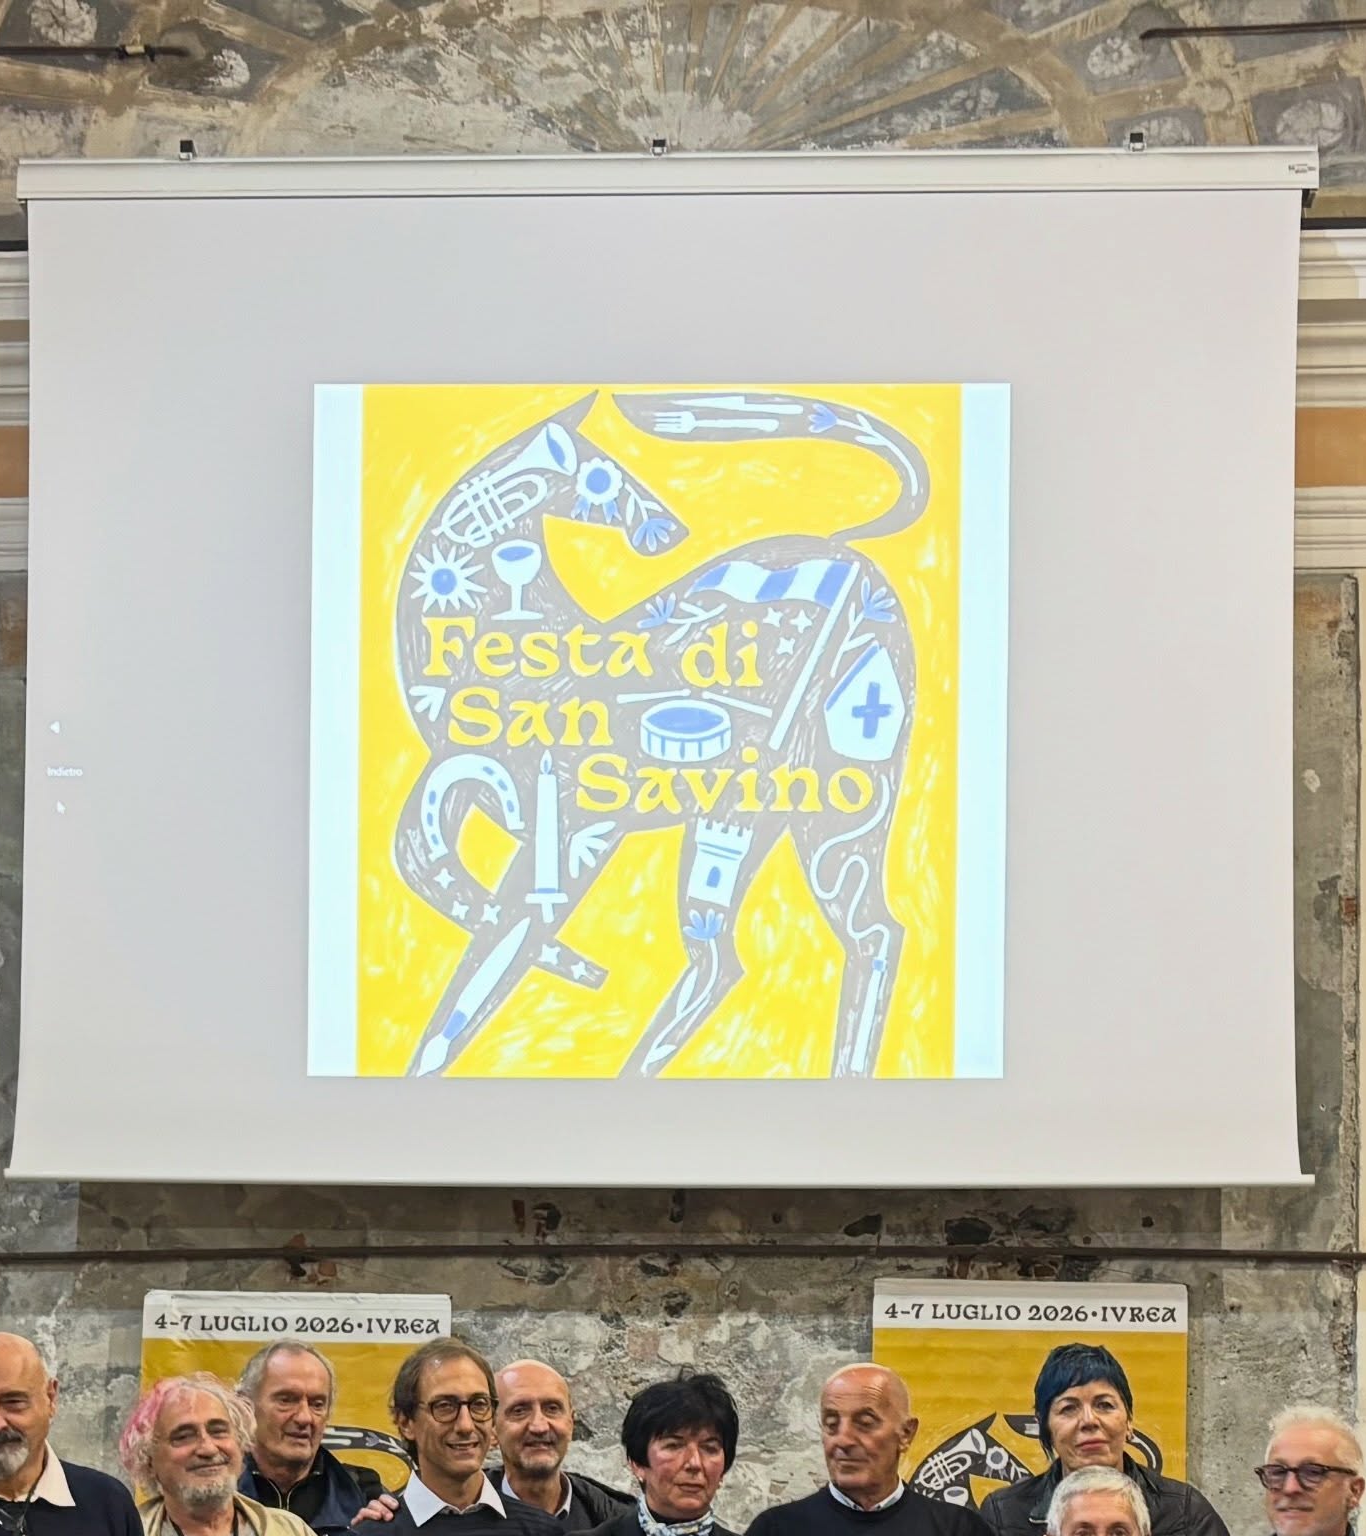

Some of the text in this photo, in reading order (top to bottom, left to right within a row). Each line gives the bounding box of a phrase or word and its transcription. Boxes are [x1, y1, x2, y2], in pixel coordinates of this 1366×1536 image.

[421, 615, 764, 688] Festa di
[447, 687, 613, 747] San
[575, 745, 874, 815] Savino
[155, 1313, 193, 1330] 4-7
[200, 1315, 288, 1332] LUGLIO
[885, 1303, 924, 1319] 4-7
[931, 1304, 1021, 1320] LUGLIO
